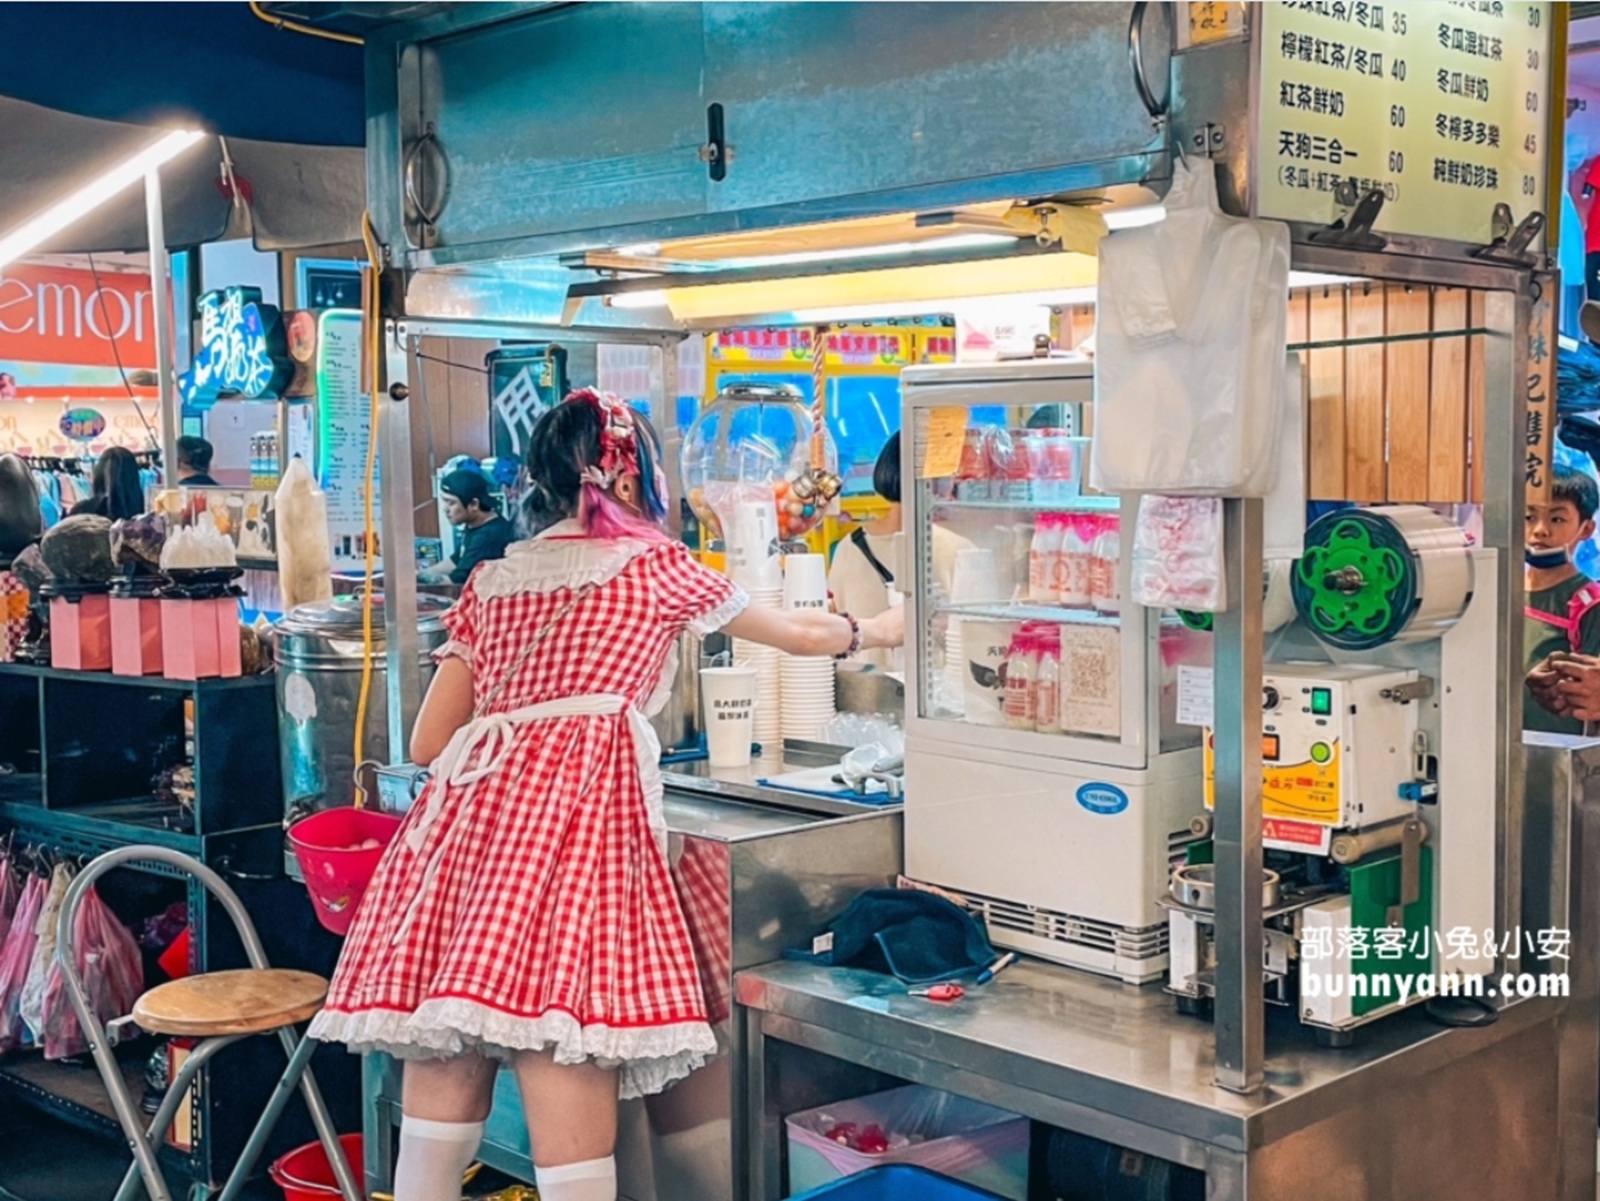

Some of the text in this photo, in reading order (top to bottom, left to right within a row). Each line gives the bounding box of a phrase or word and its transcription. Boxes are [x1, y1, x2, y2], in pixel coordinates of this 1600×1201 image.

[1391, 12, 1407, 36] 35
[1527, 6, 1540, 28] 30
[1281, 31, 1406, 82] 檸檬紅茶/冬瓜 40
[1526, 48, 1539, 71] 30
[1436, 67, 1538, 113] 冬瓜鮮奶 60
[1279, 80, 1405, 128] 紅茶鮮奶 60
[1278, 130, 1404, 174] 天狗三合一 60
[1523, 133, 1537, 154] 45
[1522, 174, 1536, 196] 80
